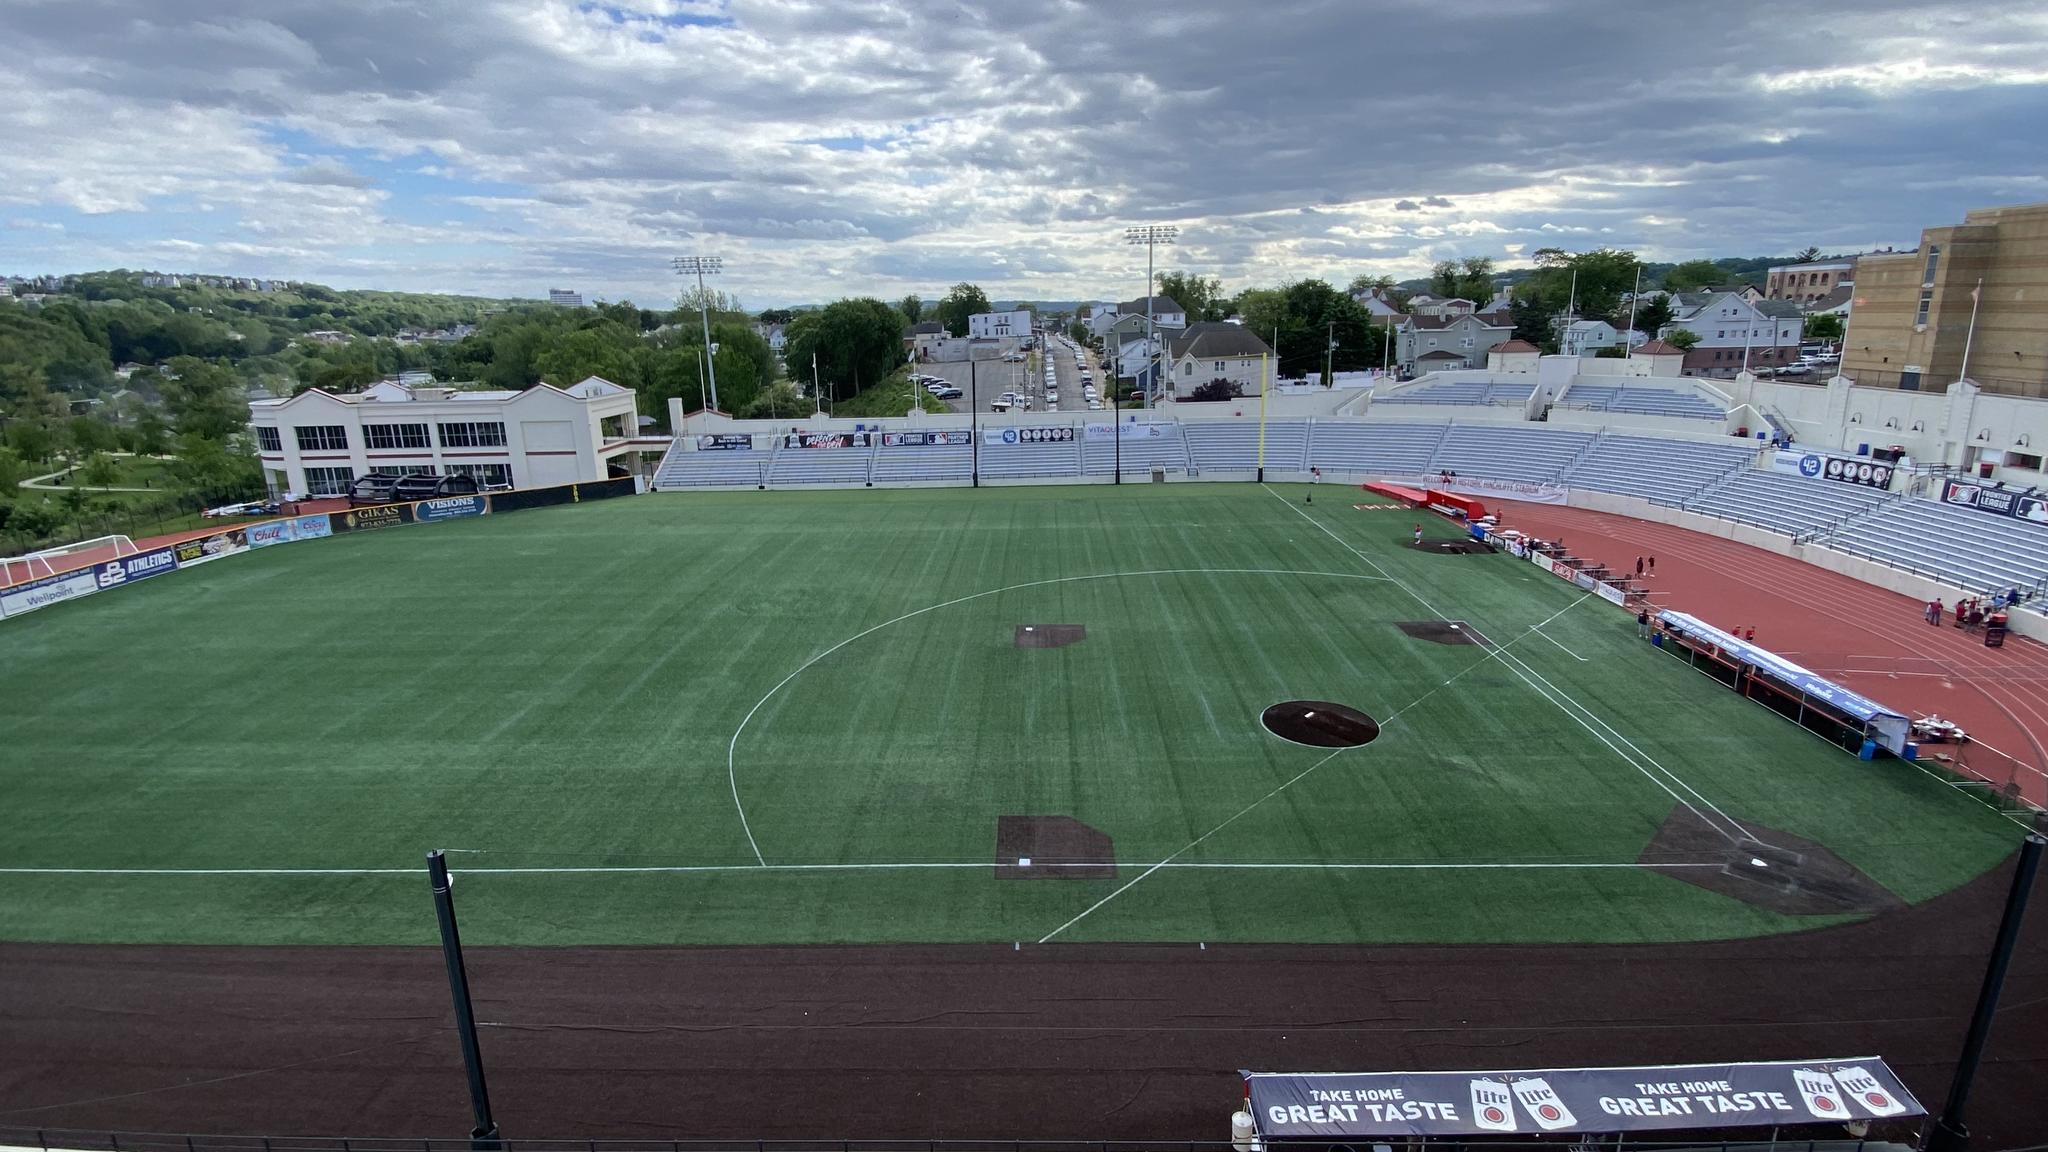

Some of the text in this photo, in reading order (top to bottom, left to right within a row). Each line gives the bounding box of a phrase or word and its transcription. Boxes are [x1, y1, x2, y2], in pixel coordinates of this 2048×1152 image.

[1004, 431, 1015, 441] 42
[1803, 458, 1817, 473] 42
[427, 497, 475, 509] VISIONS
[1980, 497, 2010, 510] LEAGUE
[358, 506, 399, 519] GIKAS
[254, 528, 281, 541] Chill
[128, 550, 172, 574] ATHLETICS
[26, 587, 74, 605] Wellpoint
[1635, 1081, 1732, 1095] TAKE HOME
[1801, 1079, 1834, 1094] Lite
[1843, 1077, 1876, 1094] Lite
[1309, 1088, 1404, 1102] TAKE HOME
[1475, 1089, 1508, 1105] Lite
[1519, 1088, 1553, 1105] Lite
[1599, 1092, 1792, 1117] GREAT TASTE
[1268, 1101, 1460, 1125] GREAT TASTE
